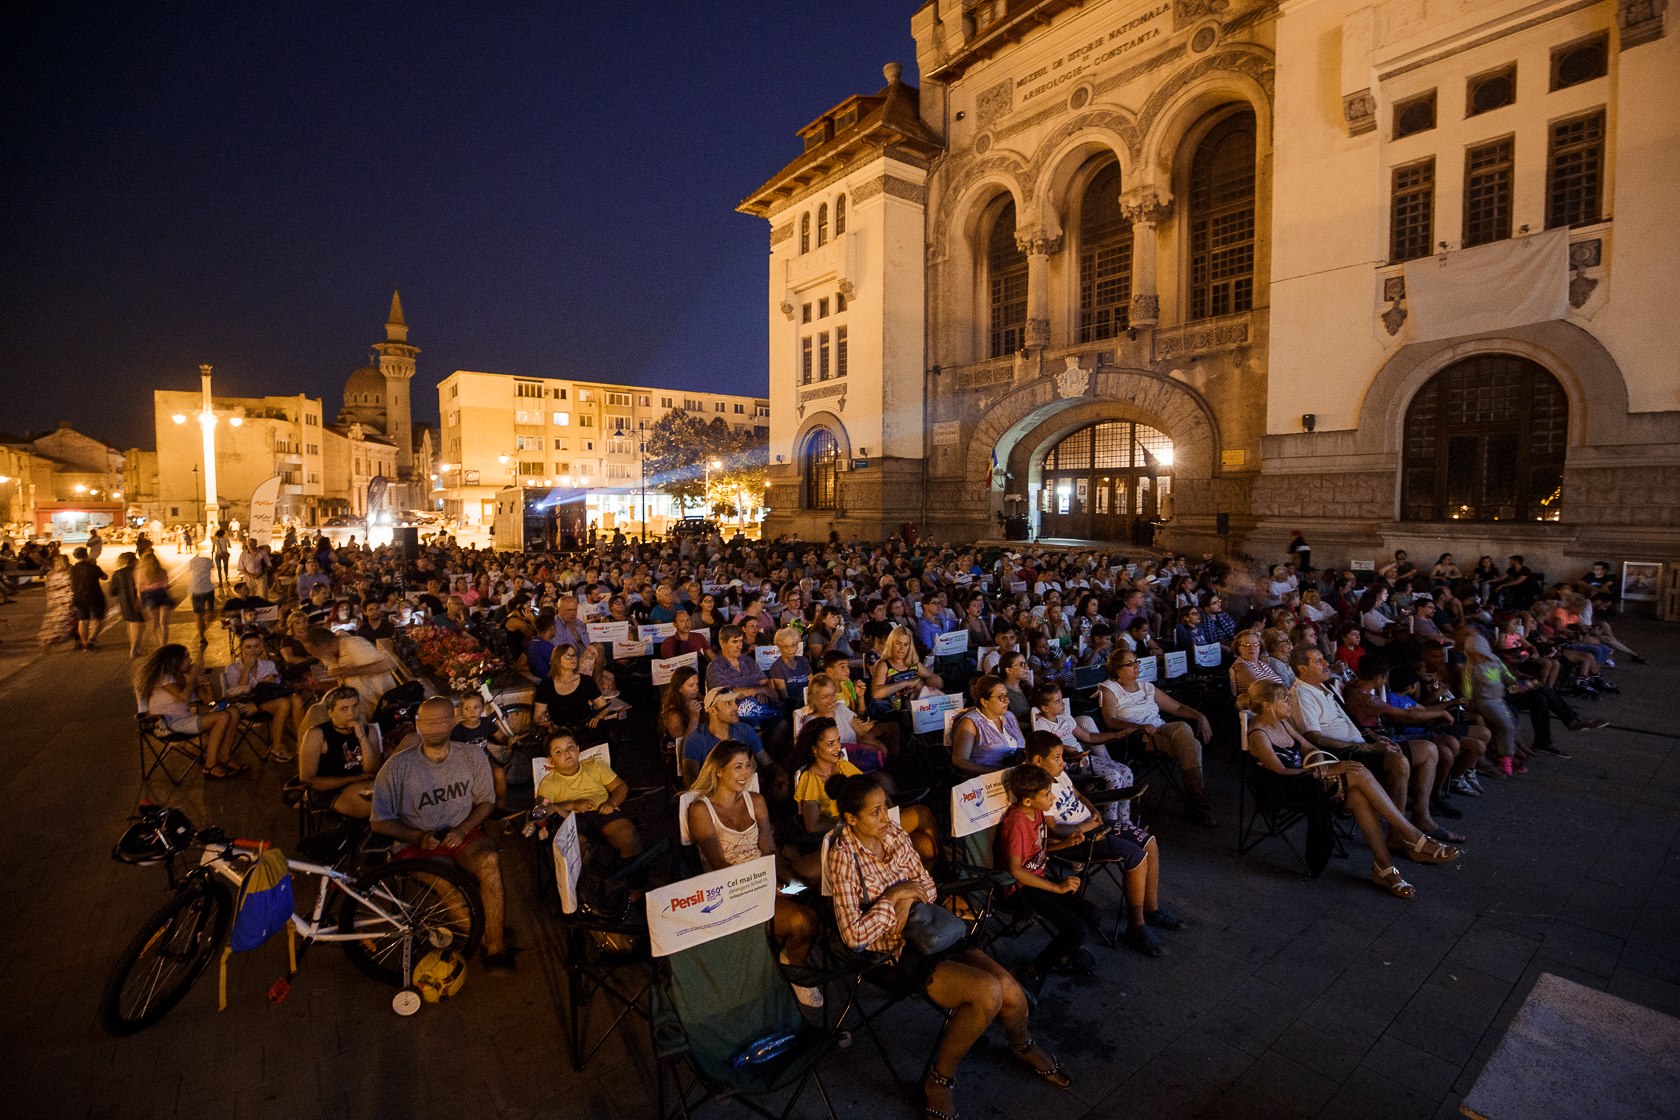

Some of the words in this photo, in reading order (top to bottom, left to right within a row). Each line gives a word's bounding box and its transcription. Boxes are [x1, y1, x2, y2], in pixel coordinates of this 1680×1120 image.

[1052, 58, 1064, 70] DE
[1067, 36, 1105, 62] ISTORIE
[1093, 28, 1161, 66] CONSTANTA
[418, 780, 470, 810] ARMY
[727, 878, 738, 888] Cel
[739, 874, 753, 884] mai
[753, 870, 767, 880] bun
[670, 890, 705, 912] Persil
